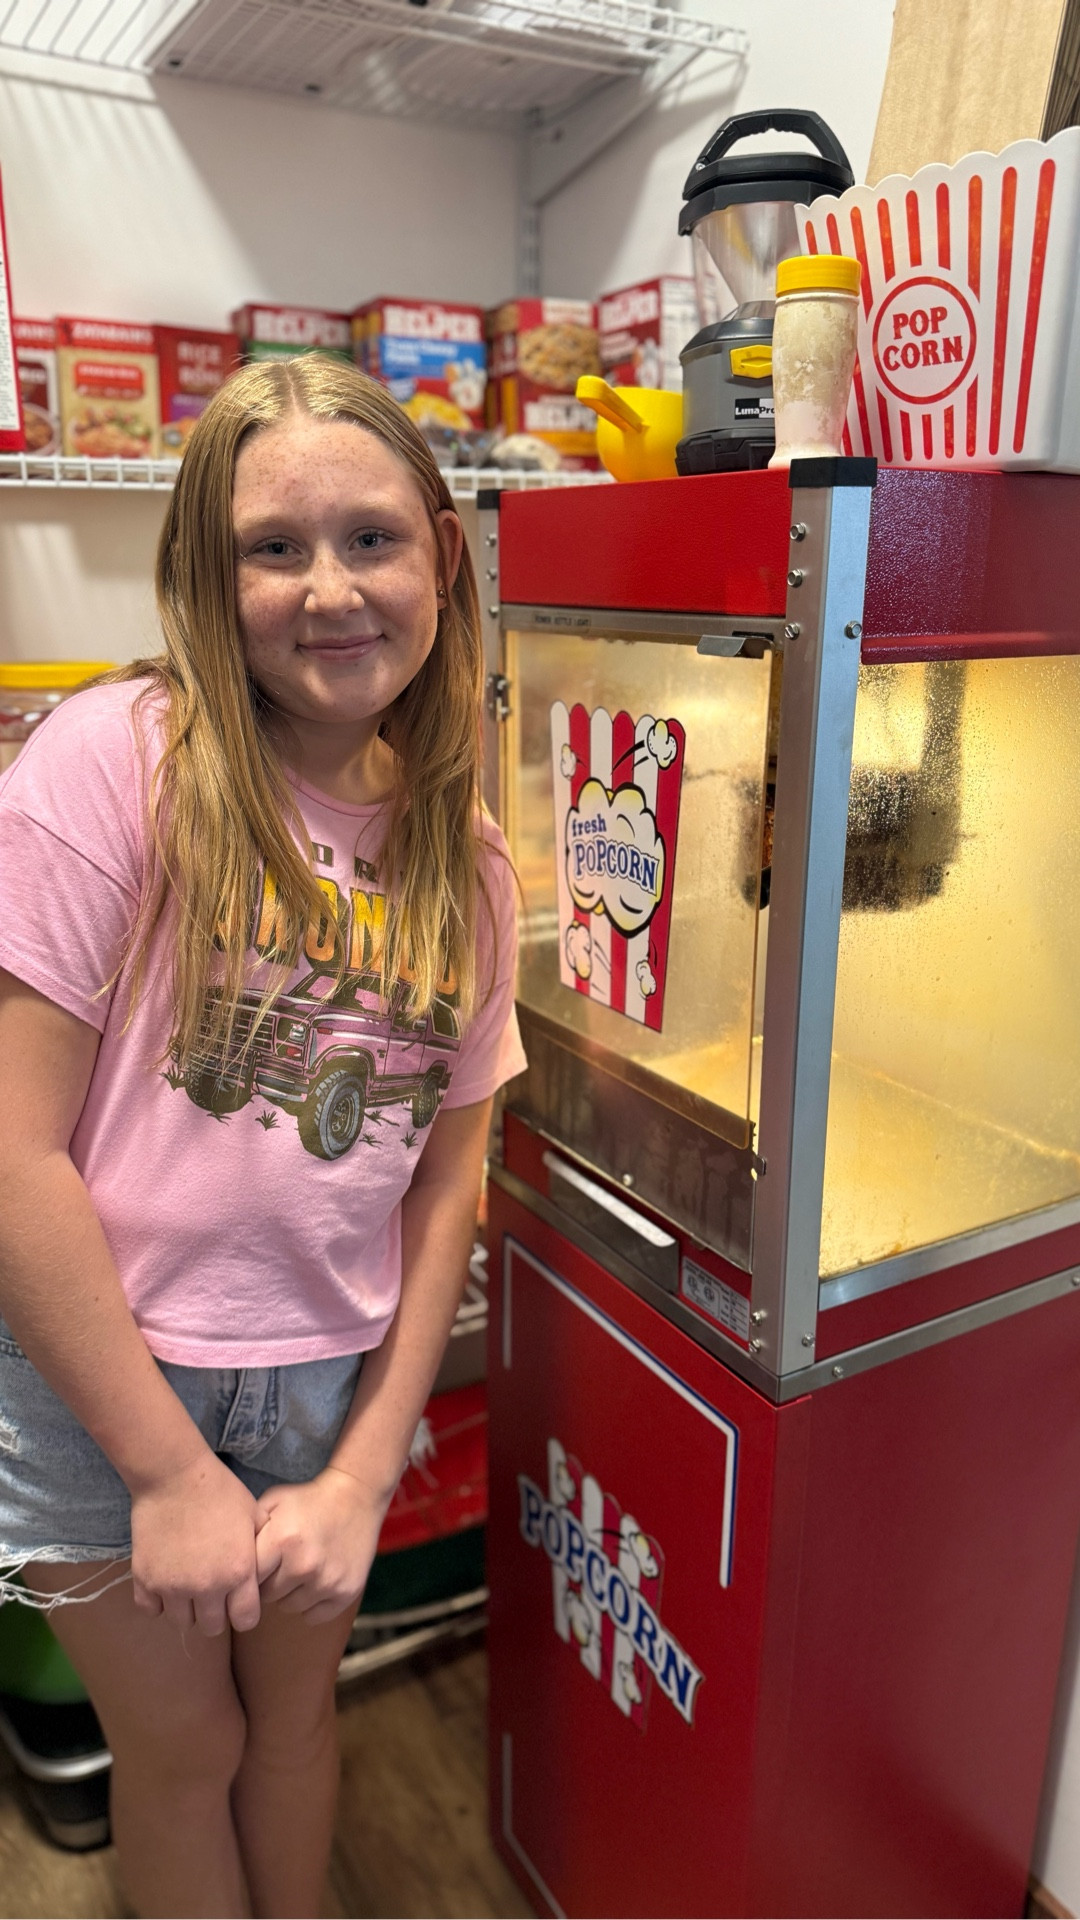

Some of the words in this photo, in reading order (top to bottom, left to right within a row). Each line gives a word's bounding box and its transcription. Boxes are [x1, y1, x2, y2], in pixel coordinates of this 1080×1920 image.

[254, 310, 350, 347] HELPER
[384, 305, 481, 342] HELPER
[892, 306, 948, 340] POP
[883, 335, 964, 371] CORN
[525, 402, 598, 432] HELPE
[572, 813, 607, 837] fresh
[574, 838, 657, 892] POPCORN
[520, 1482, 693, 1711] POPCORN
